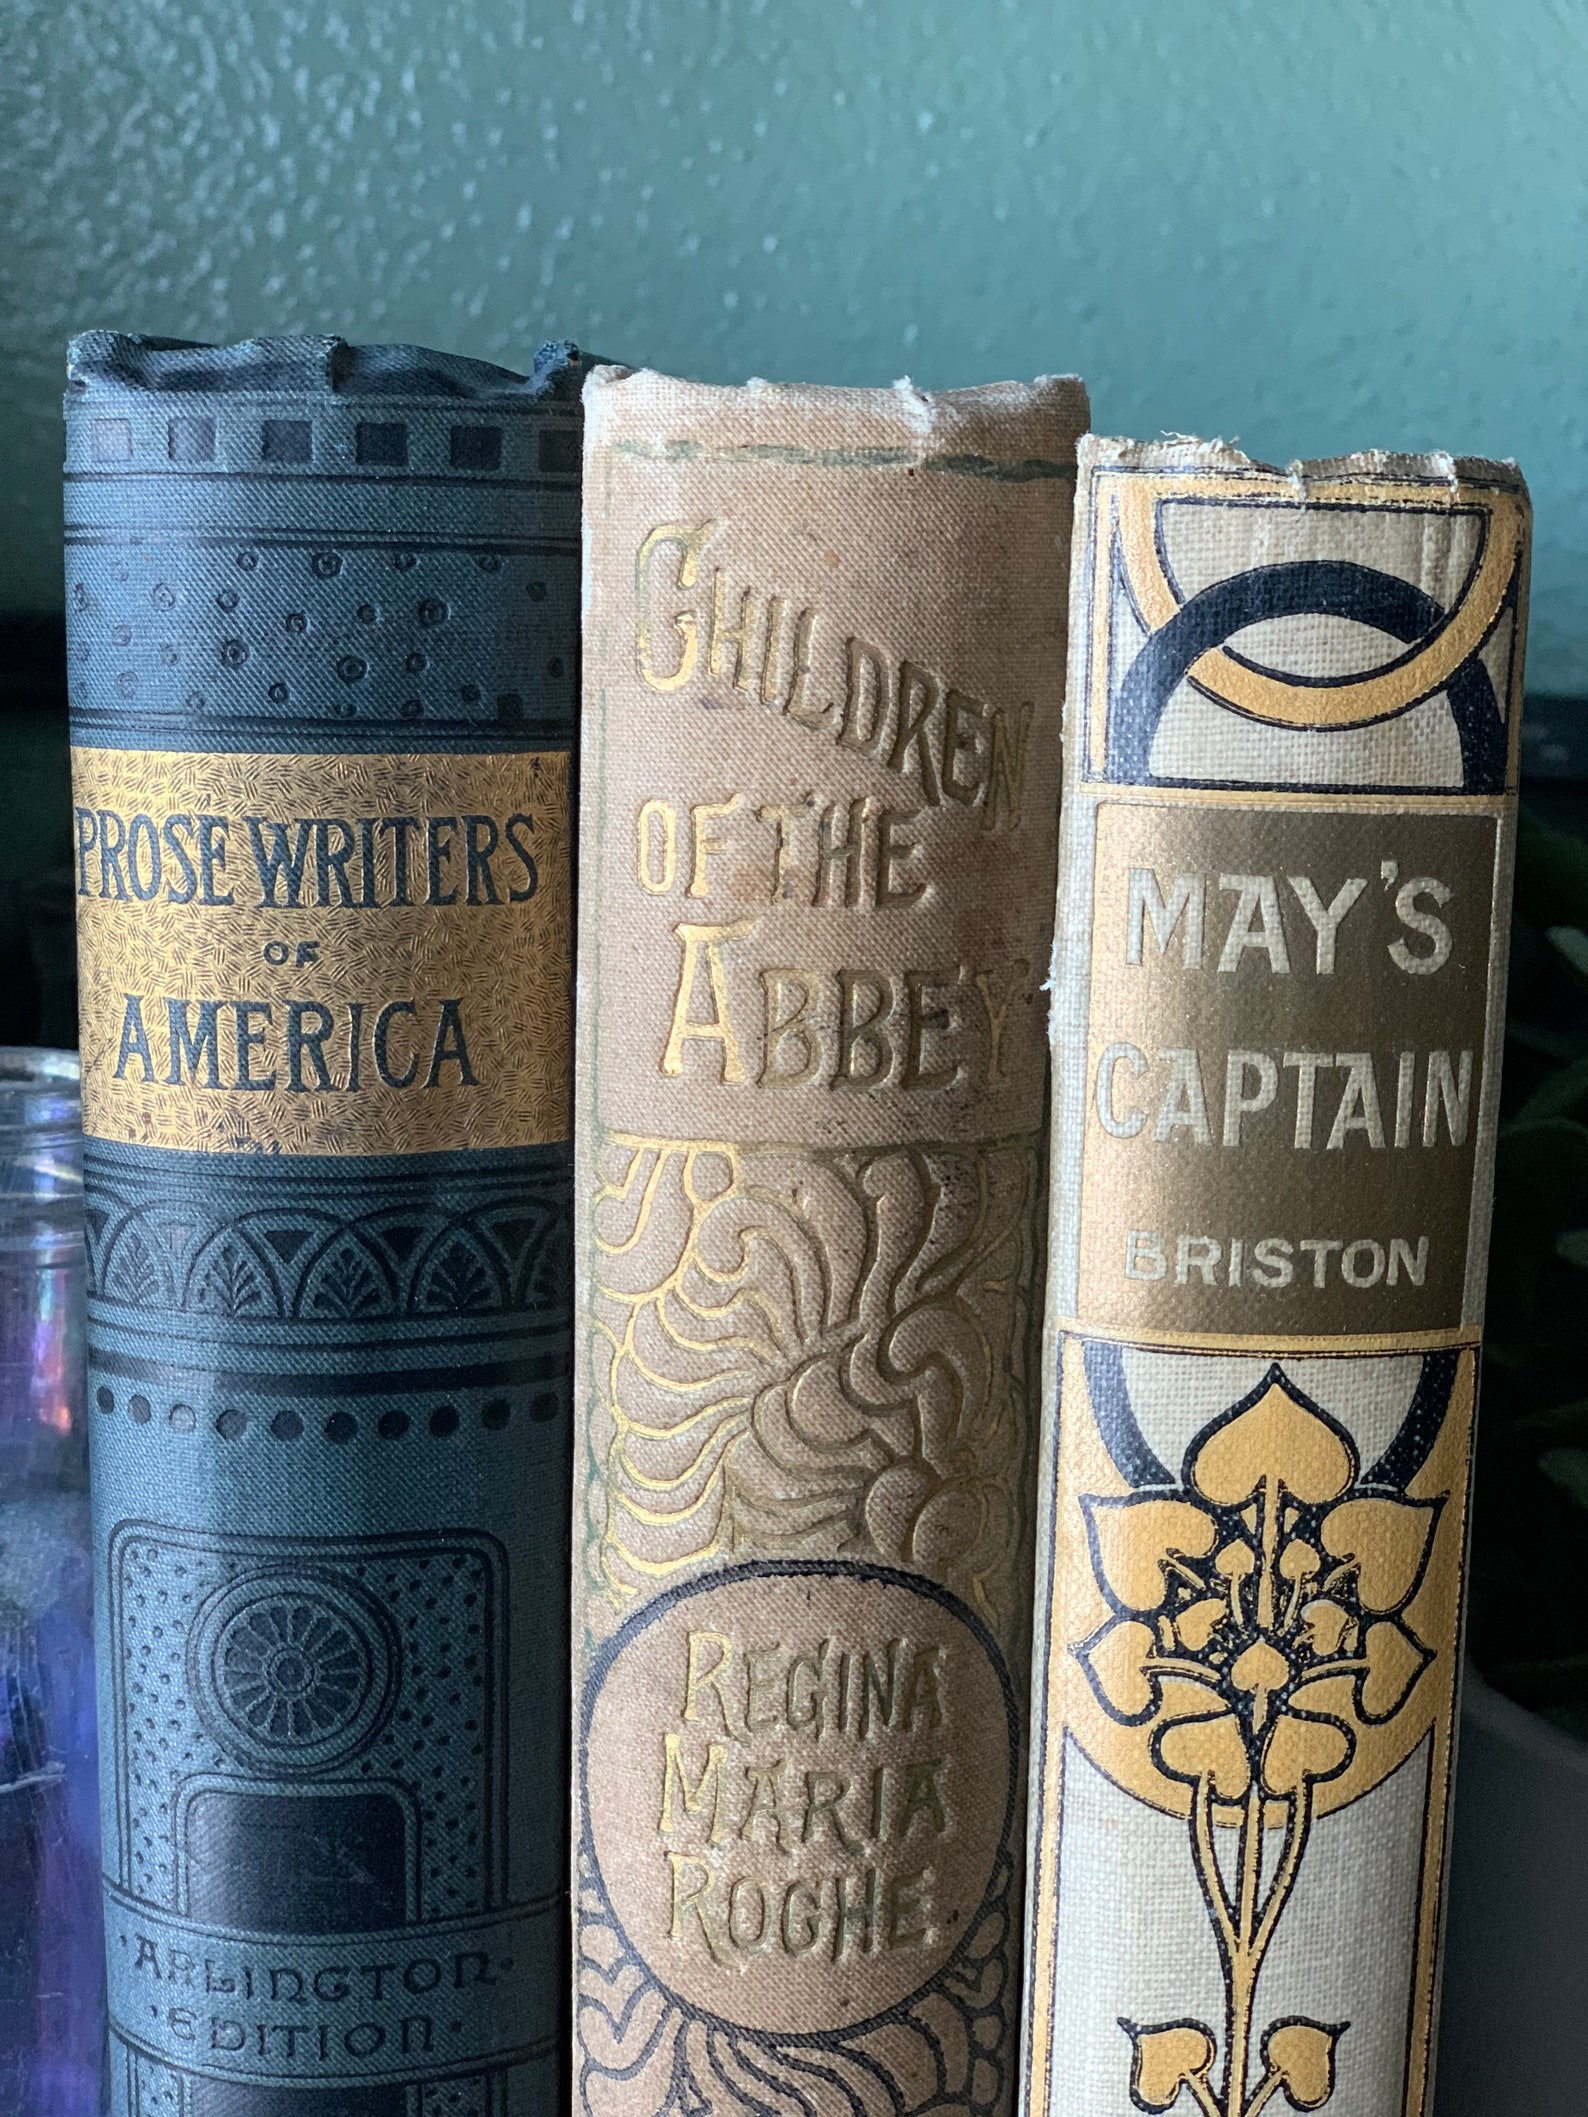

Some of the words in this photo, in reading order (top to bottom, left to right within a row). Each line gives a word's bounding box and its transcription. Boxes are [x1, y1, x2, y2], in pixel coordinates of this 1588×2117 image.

[75, 807, 234, 906] PROSE
[242, 813, 538, 908] WRITERS
[636, 794, 742, 896] OF
[756, 797, 933, 908] THE
[263, 940, 320, 968] OF
[1125, 860, 1455, 976] MAY'S
[115, 993, 482, 1093] AMERICA
[662, 918, 1032, 1092] ABBEY
[1095, 1042, 1473, 1151] CAPTAIN
[1123, 1228, 1430, 1290] BRISTON
[682, 1630, 948, 1748] REGINA
[658, 1732, 950, 1858] MARIA
